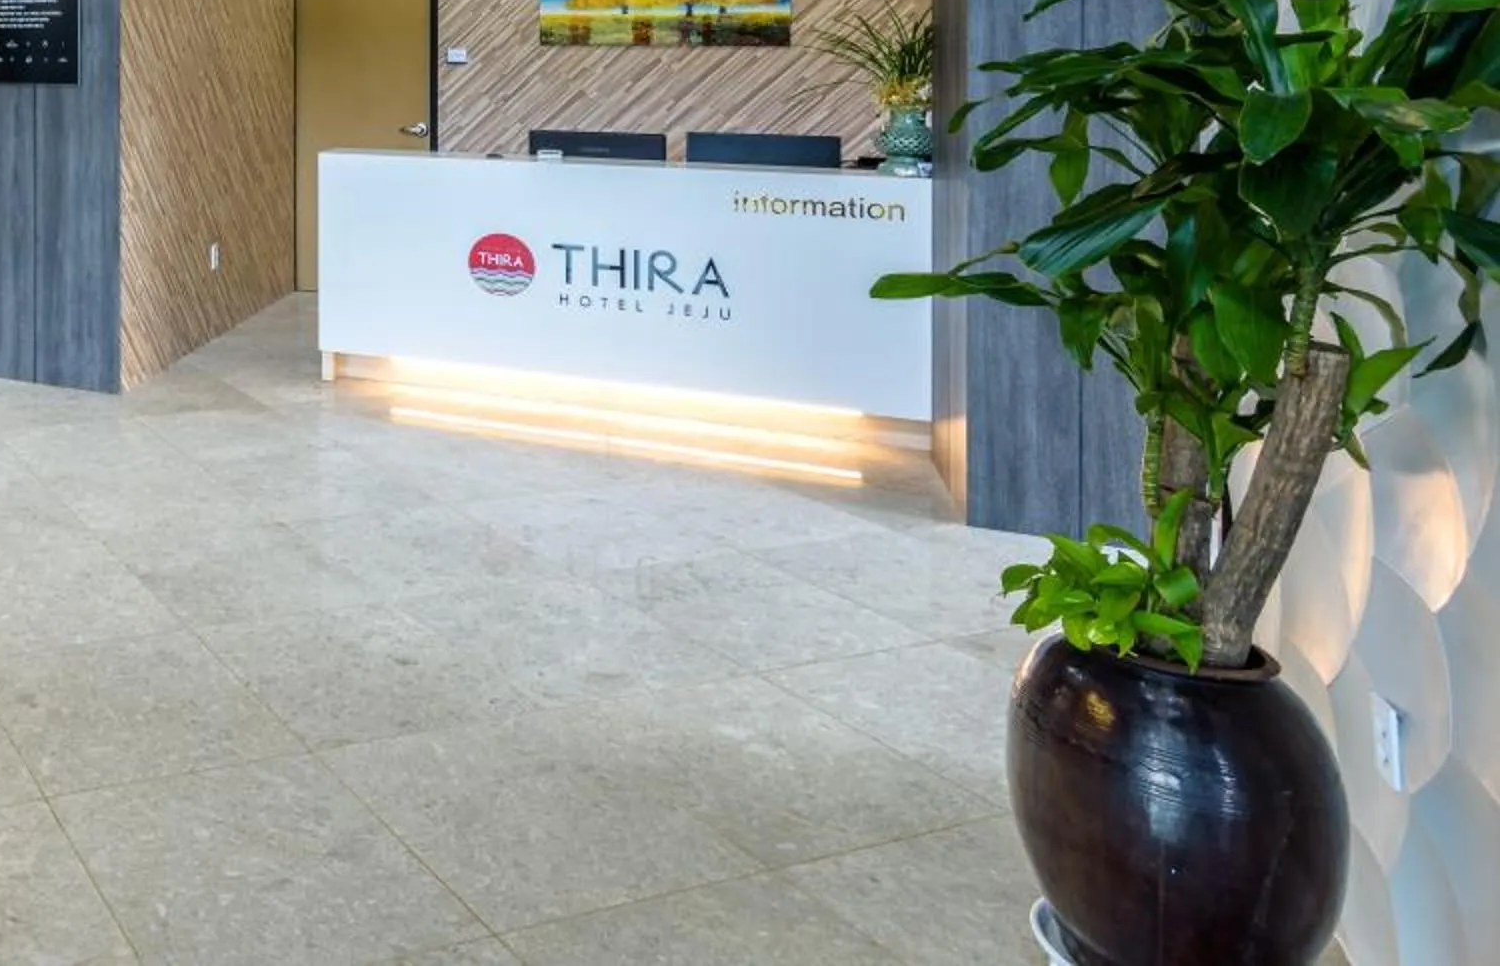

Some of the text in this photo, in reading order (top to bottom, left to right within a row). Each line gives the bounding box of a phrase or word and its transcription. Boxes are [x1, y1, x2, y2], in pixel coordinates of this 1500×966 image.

[733, 190, 906, 222] information
[478, 251, 525, 267] THIRA
[551, 243, 731, 298] THIRA
[559, 294, 732, 321] HOTEL JEJU
